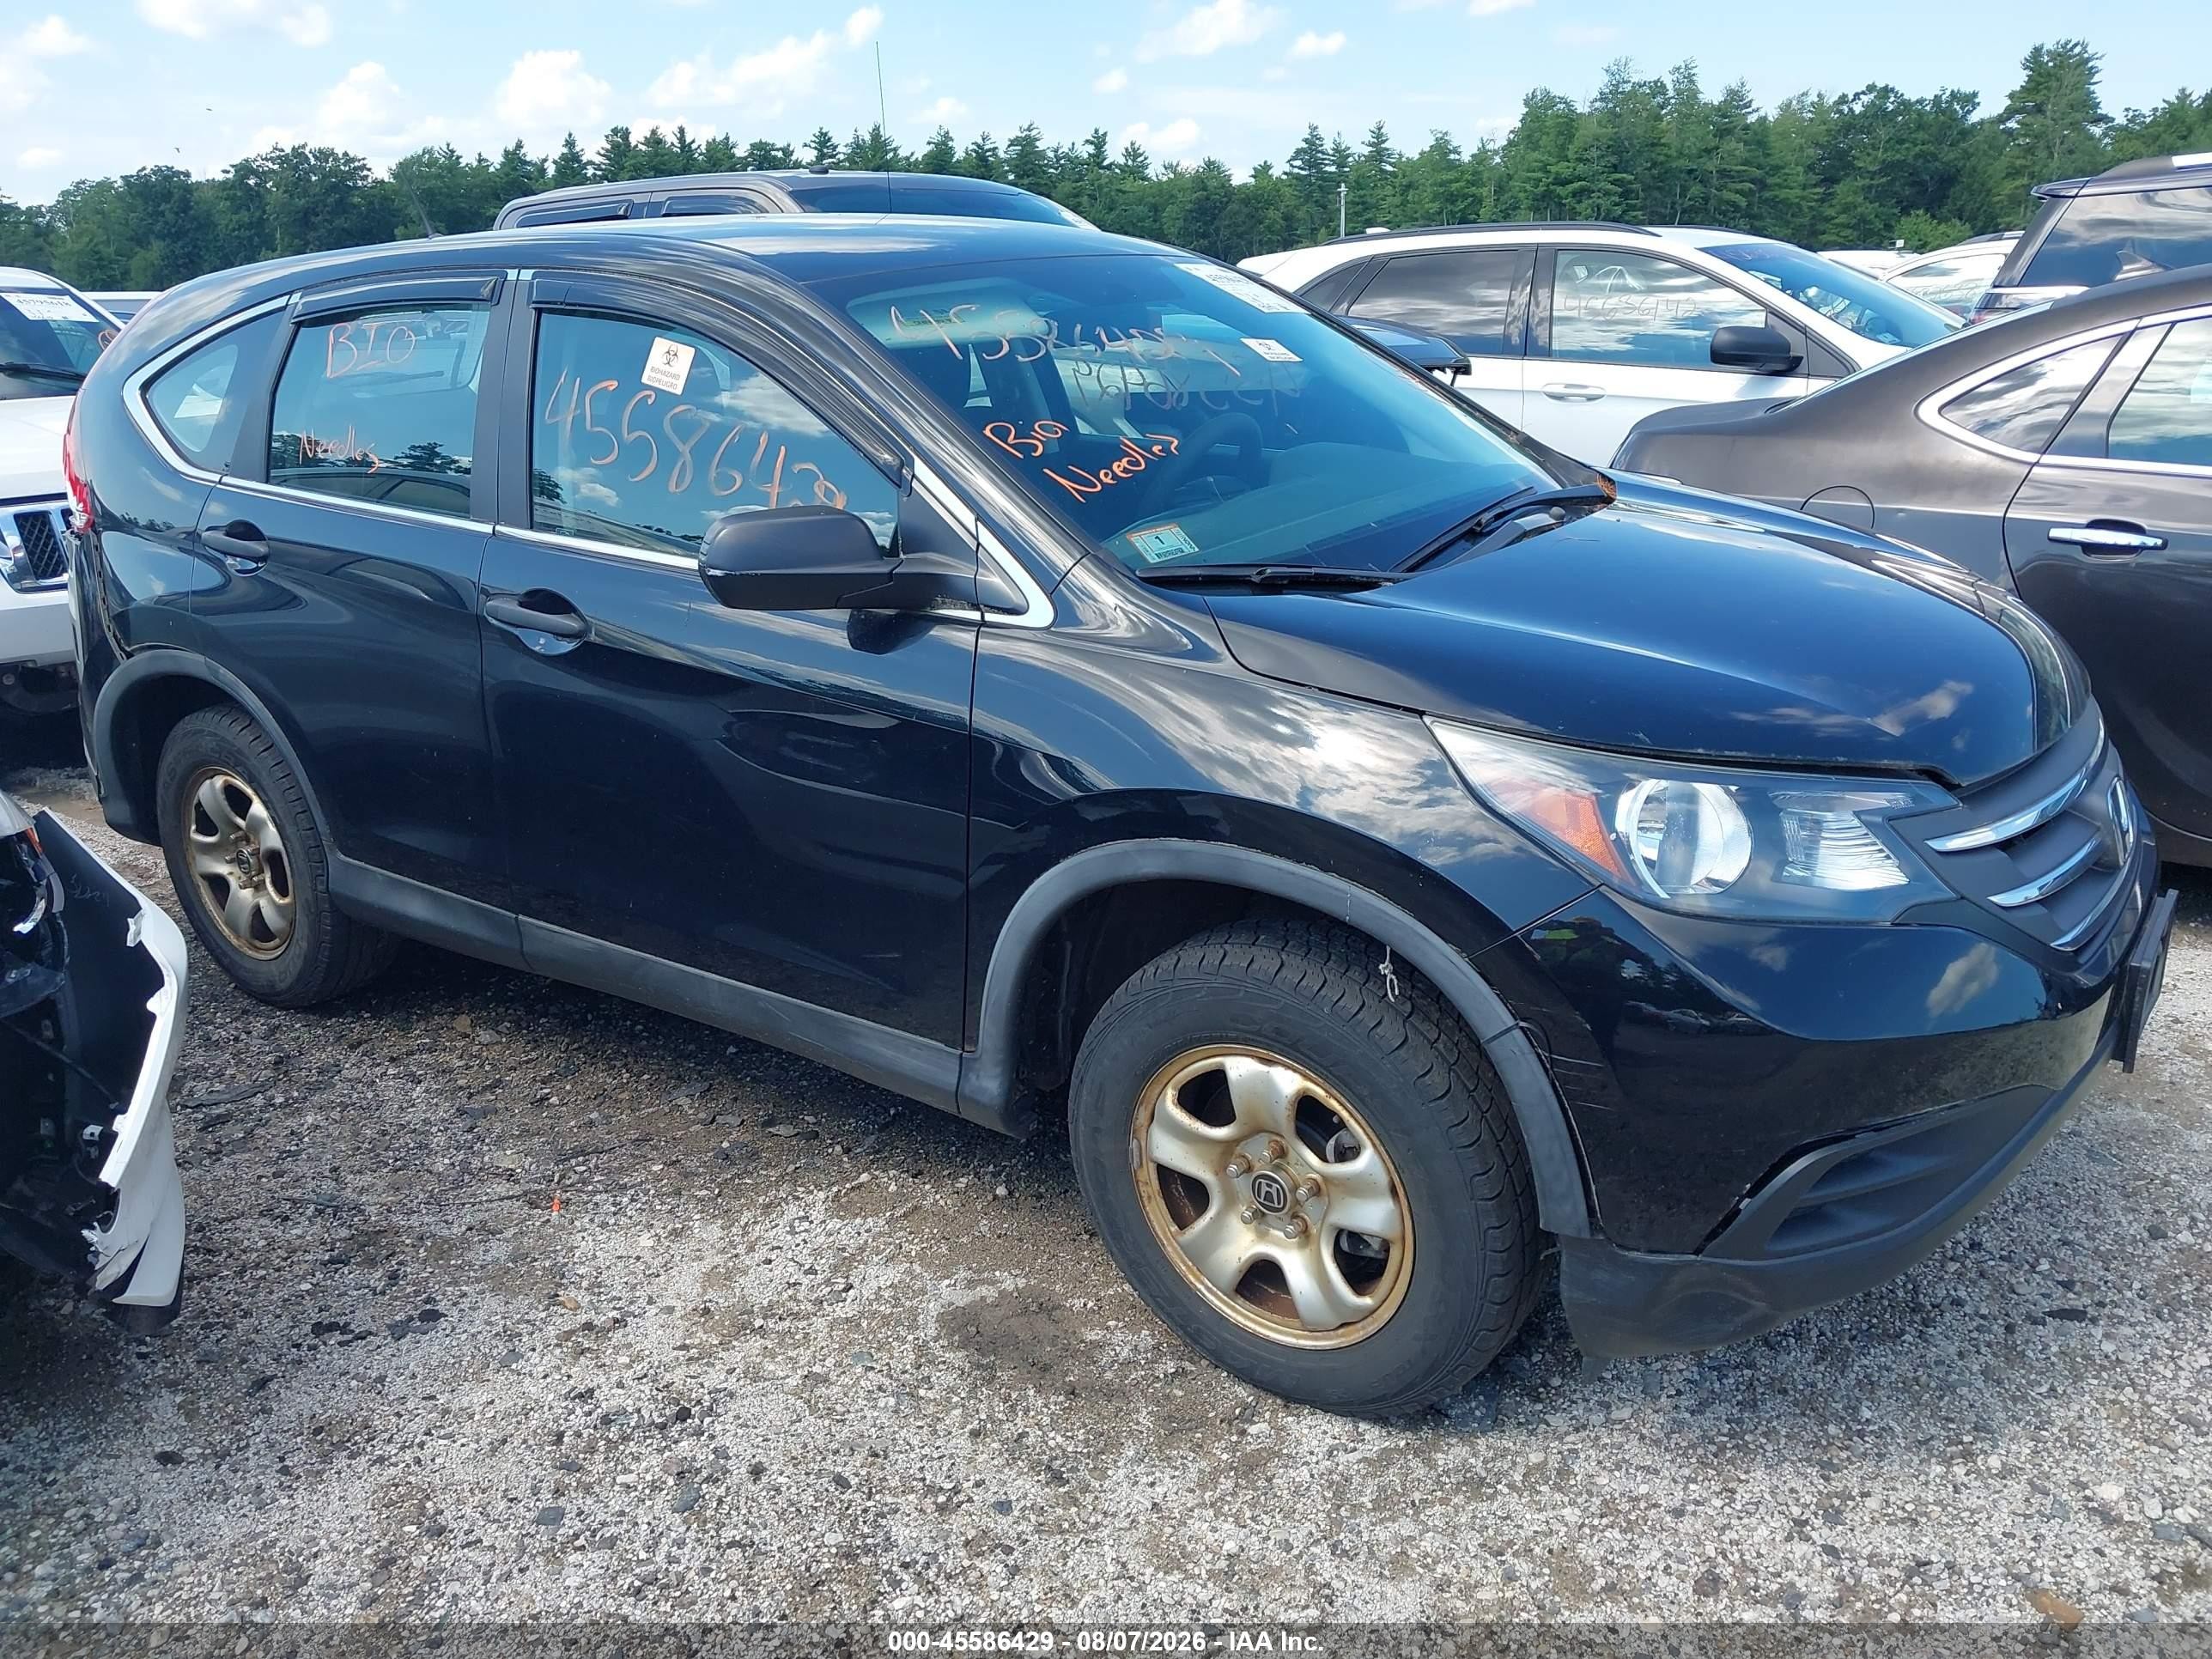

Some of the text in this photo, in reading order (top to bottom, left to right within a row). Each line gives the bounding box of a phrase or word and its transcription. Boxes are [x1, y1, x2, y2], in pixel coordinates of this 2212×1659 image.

[326, 322, 416, 378] BIO
[647, 374, 678, 391] BIOPELIGRO
[650, 366, 681, 381] BIOHAZARD
[300, 425, 380, 474] Needles
[1042, 433, 1180, 503] Needles
[1154, 535, 1166, 545] 1
